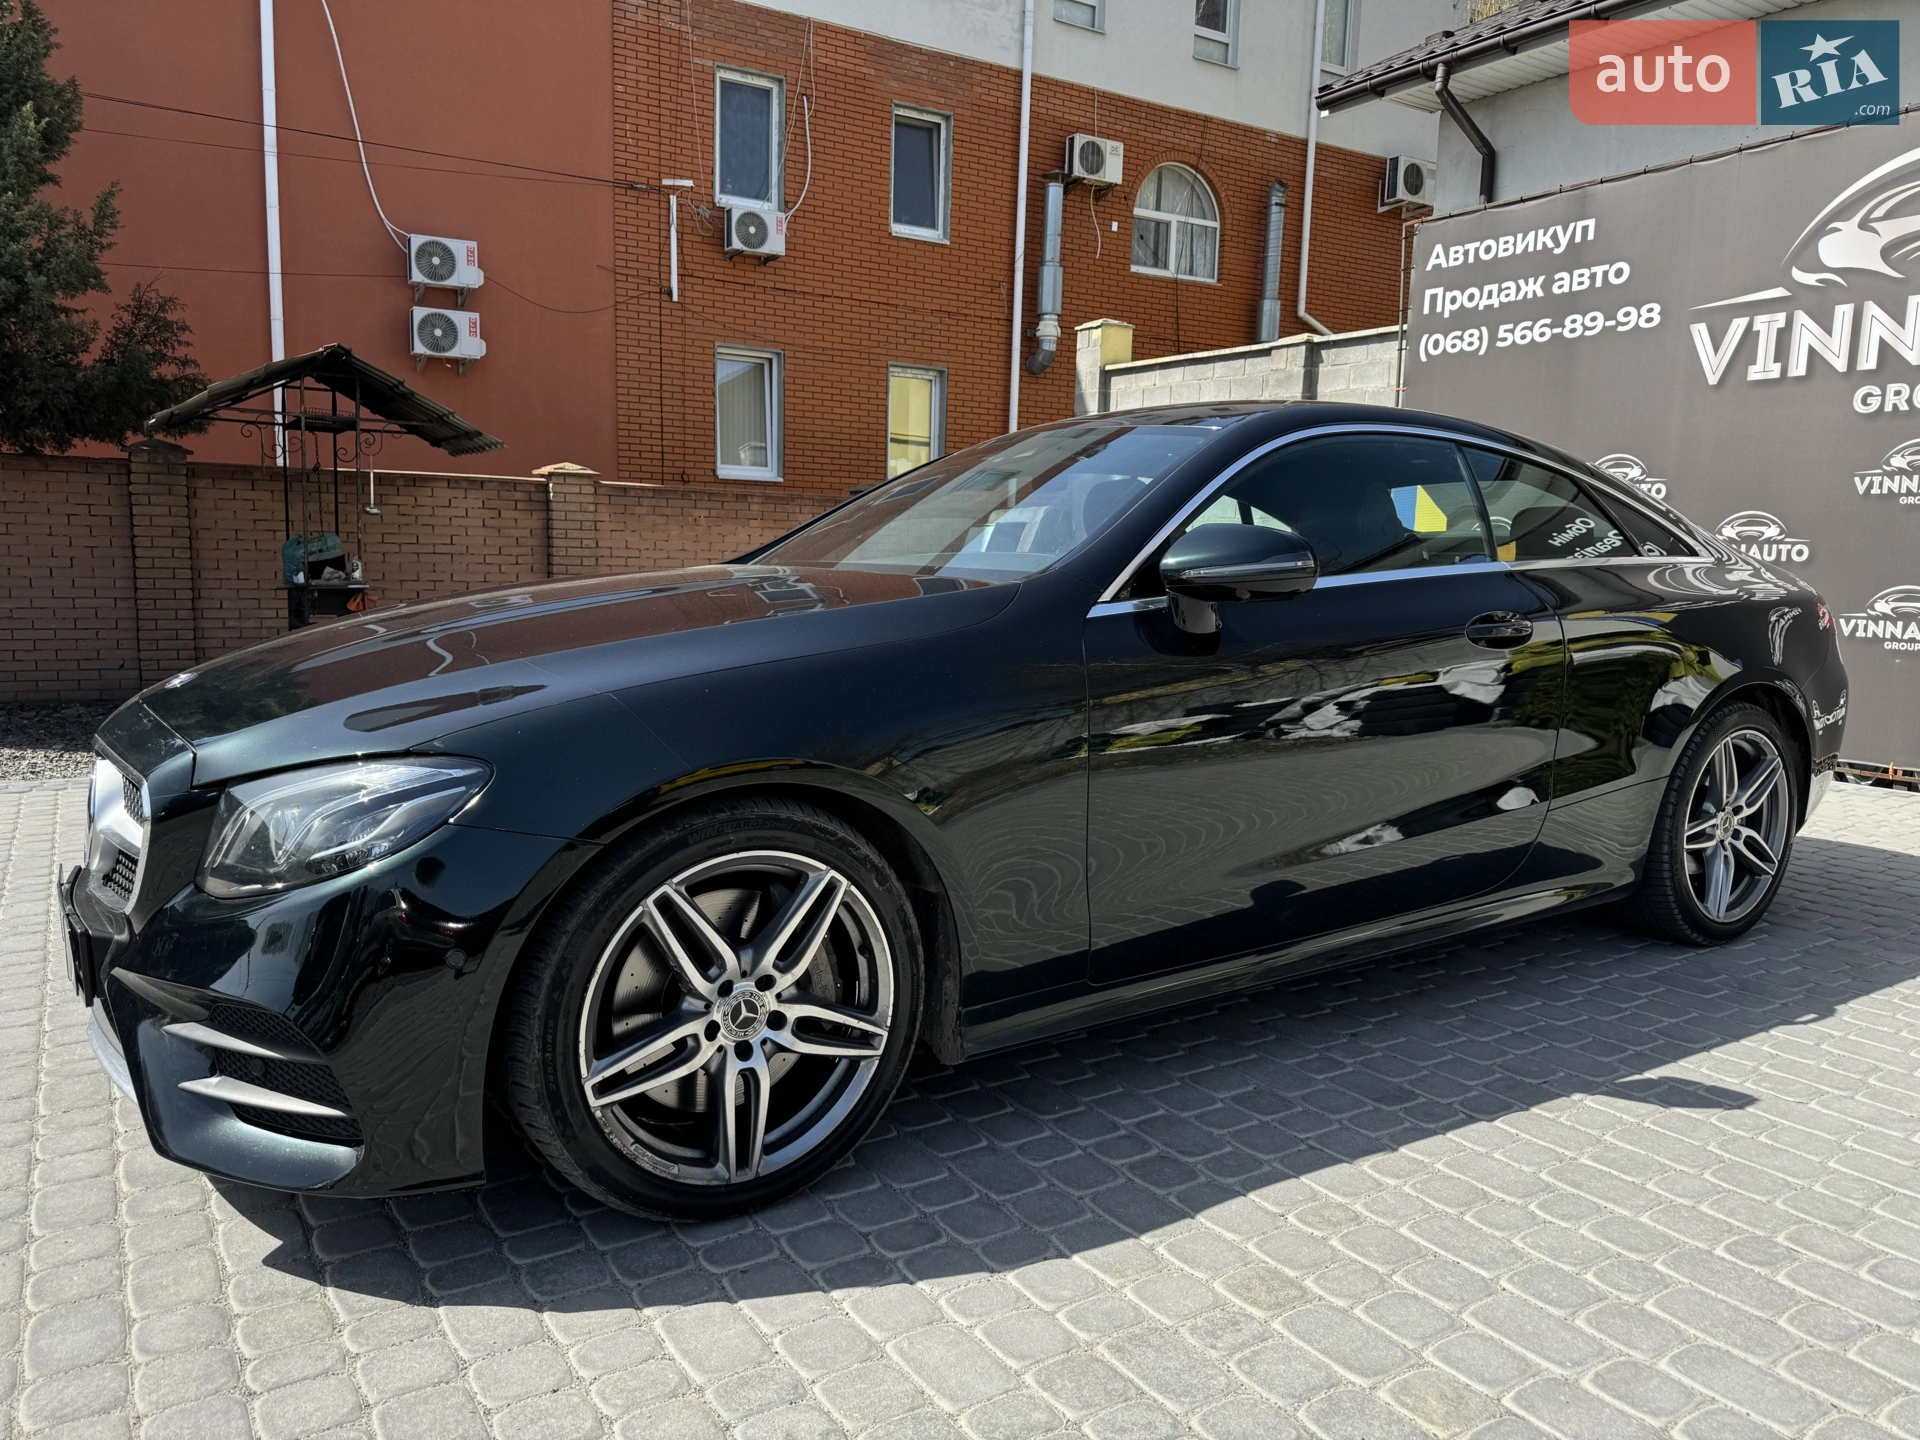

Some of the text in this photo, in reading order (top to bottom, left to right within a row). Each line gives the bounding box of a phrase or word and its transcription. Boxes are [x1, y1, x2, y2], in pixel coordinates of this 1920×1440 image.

[1425, 218, 1596, 271] Автовикуп
[1422, 261, 1631, 318] Продаж авто
[1418, 302, 1661, 363] (068) 566-89-98
[1852, 382, 1920, 414] GR
[1854, 474, 1920, 495] VINN
